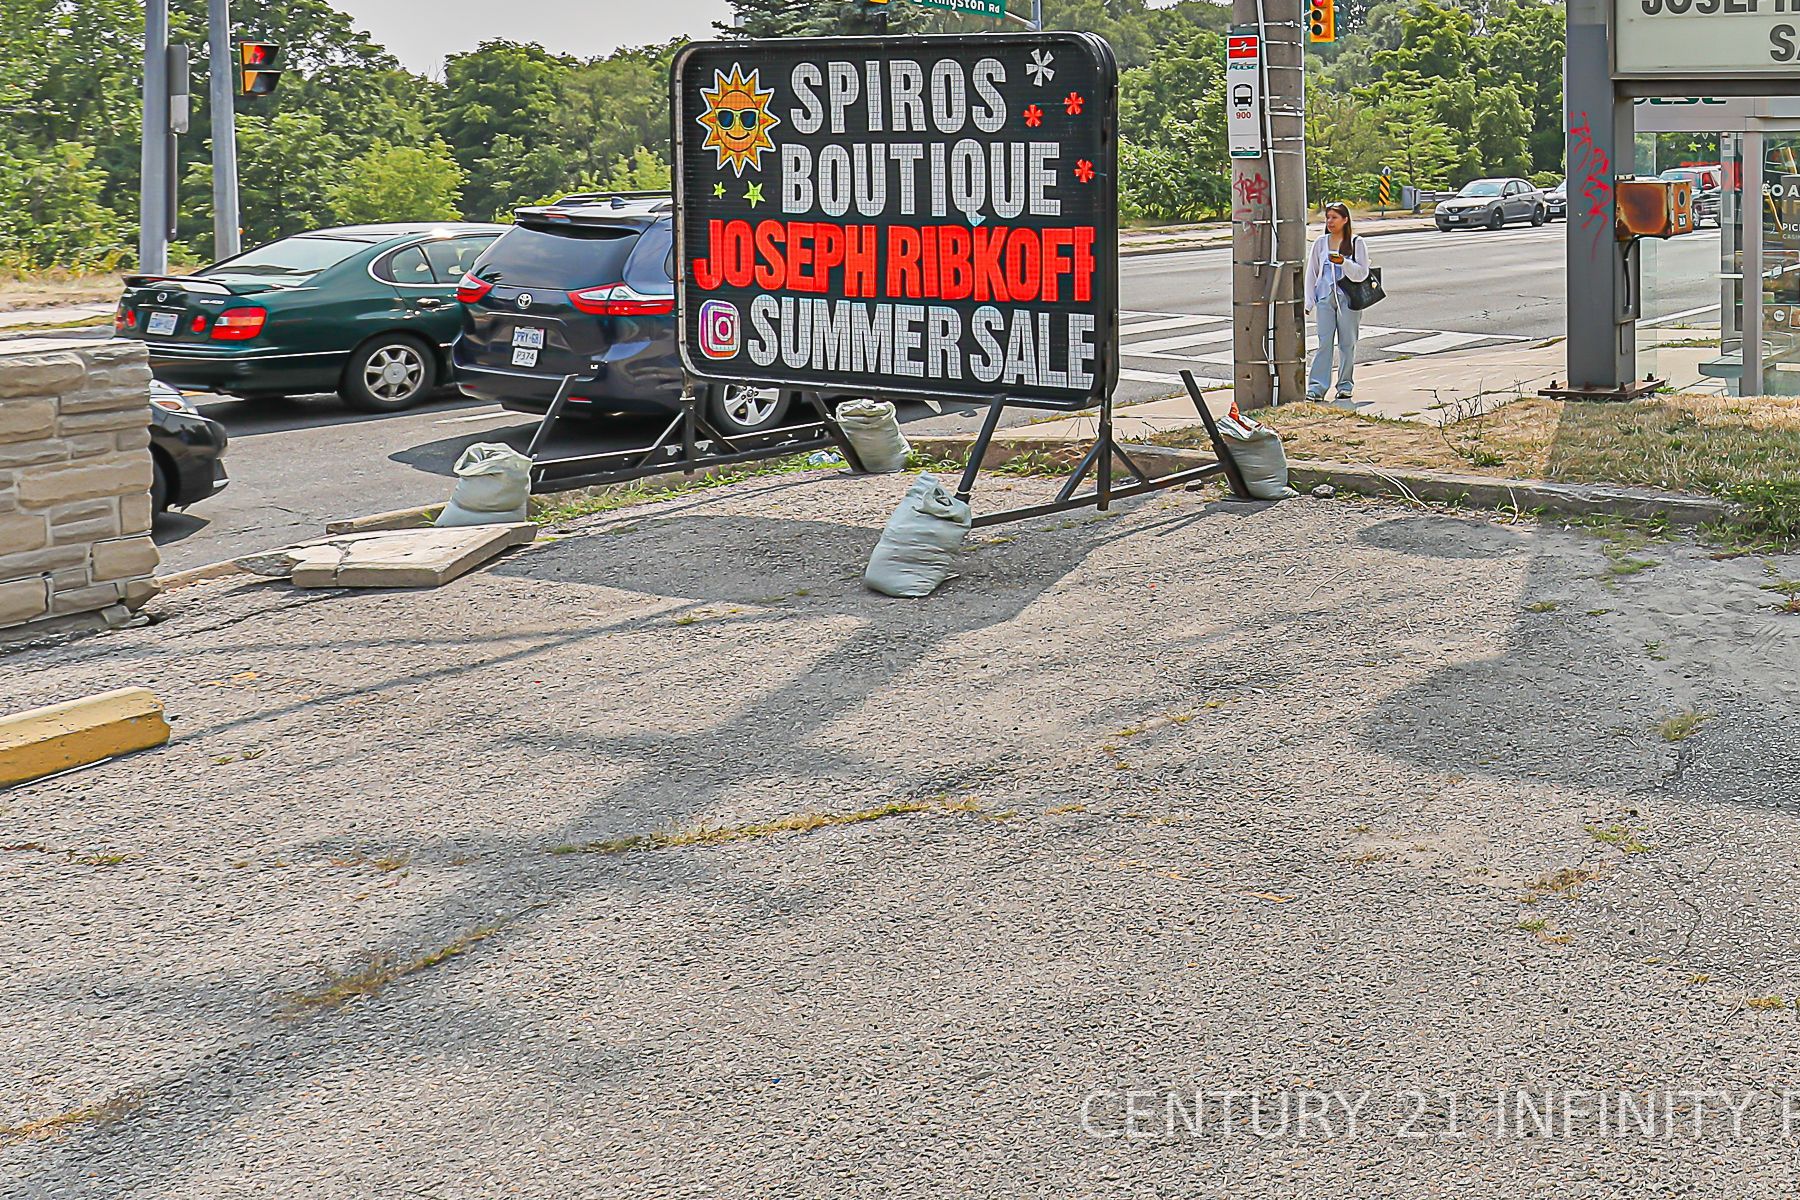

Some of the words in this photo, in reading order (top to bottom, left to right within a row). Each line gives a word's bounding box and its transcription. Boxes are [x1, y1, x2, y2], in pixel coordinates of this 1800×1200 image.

[988, 2, 1001, 14] Rd
[790, 58, 1008, 135] SPIROS
[1235, 111, 1252, 120] 900
[781, 138, 1062, 228] BOUTIQUE
[693, 219, 878, 298] JOSEPH
[886, 224, 1096, 302] RIBKOFF
[746, 294, 964, 380] SUMMER
[969, 305, 1096, 391] SALE
